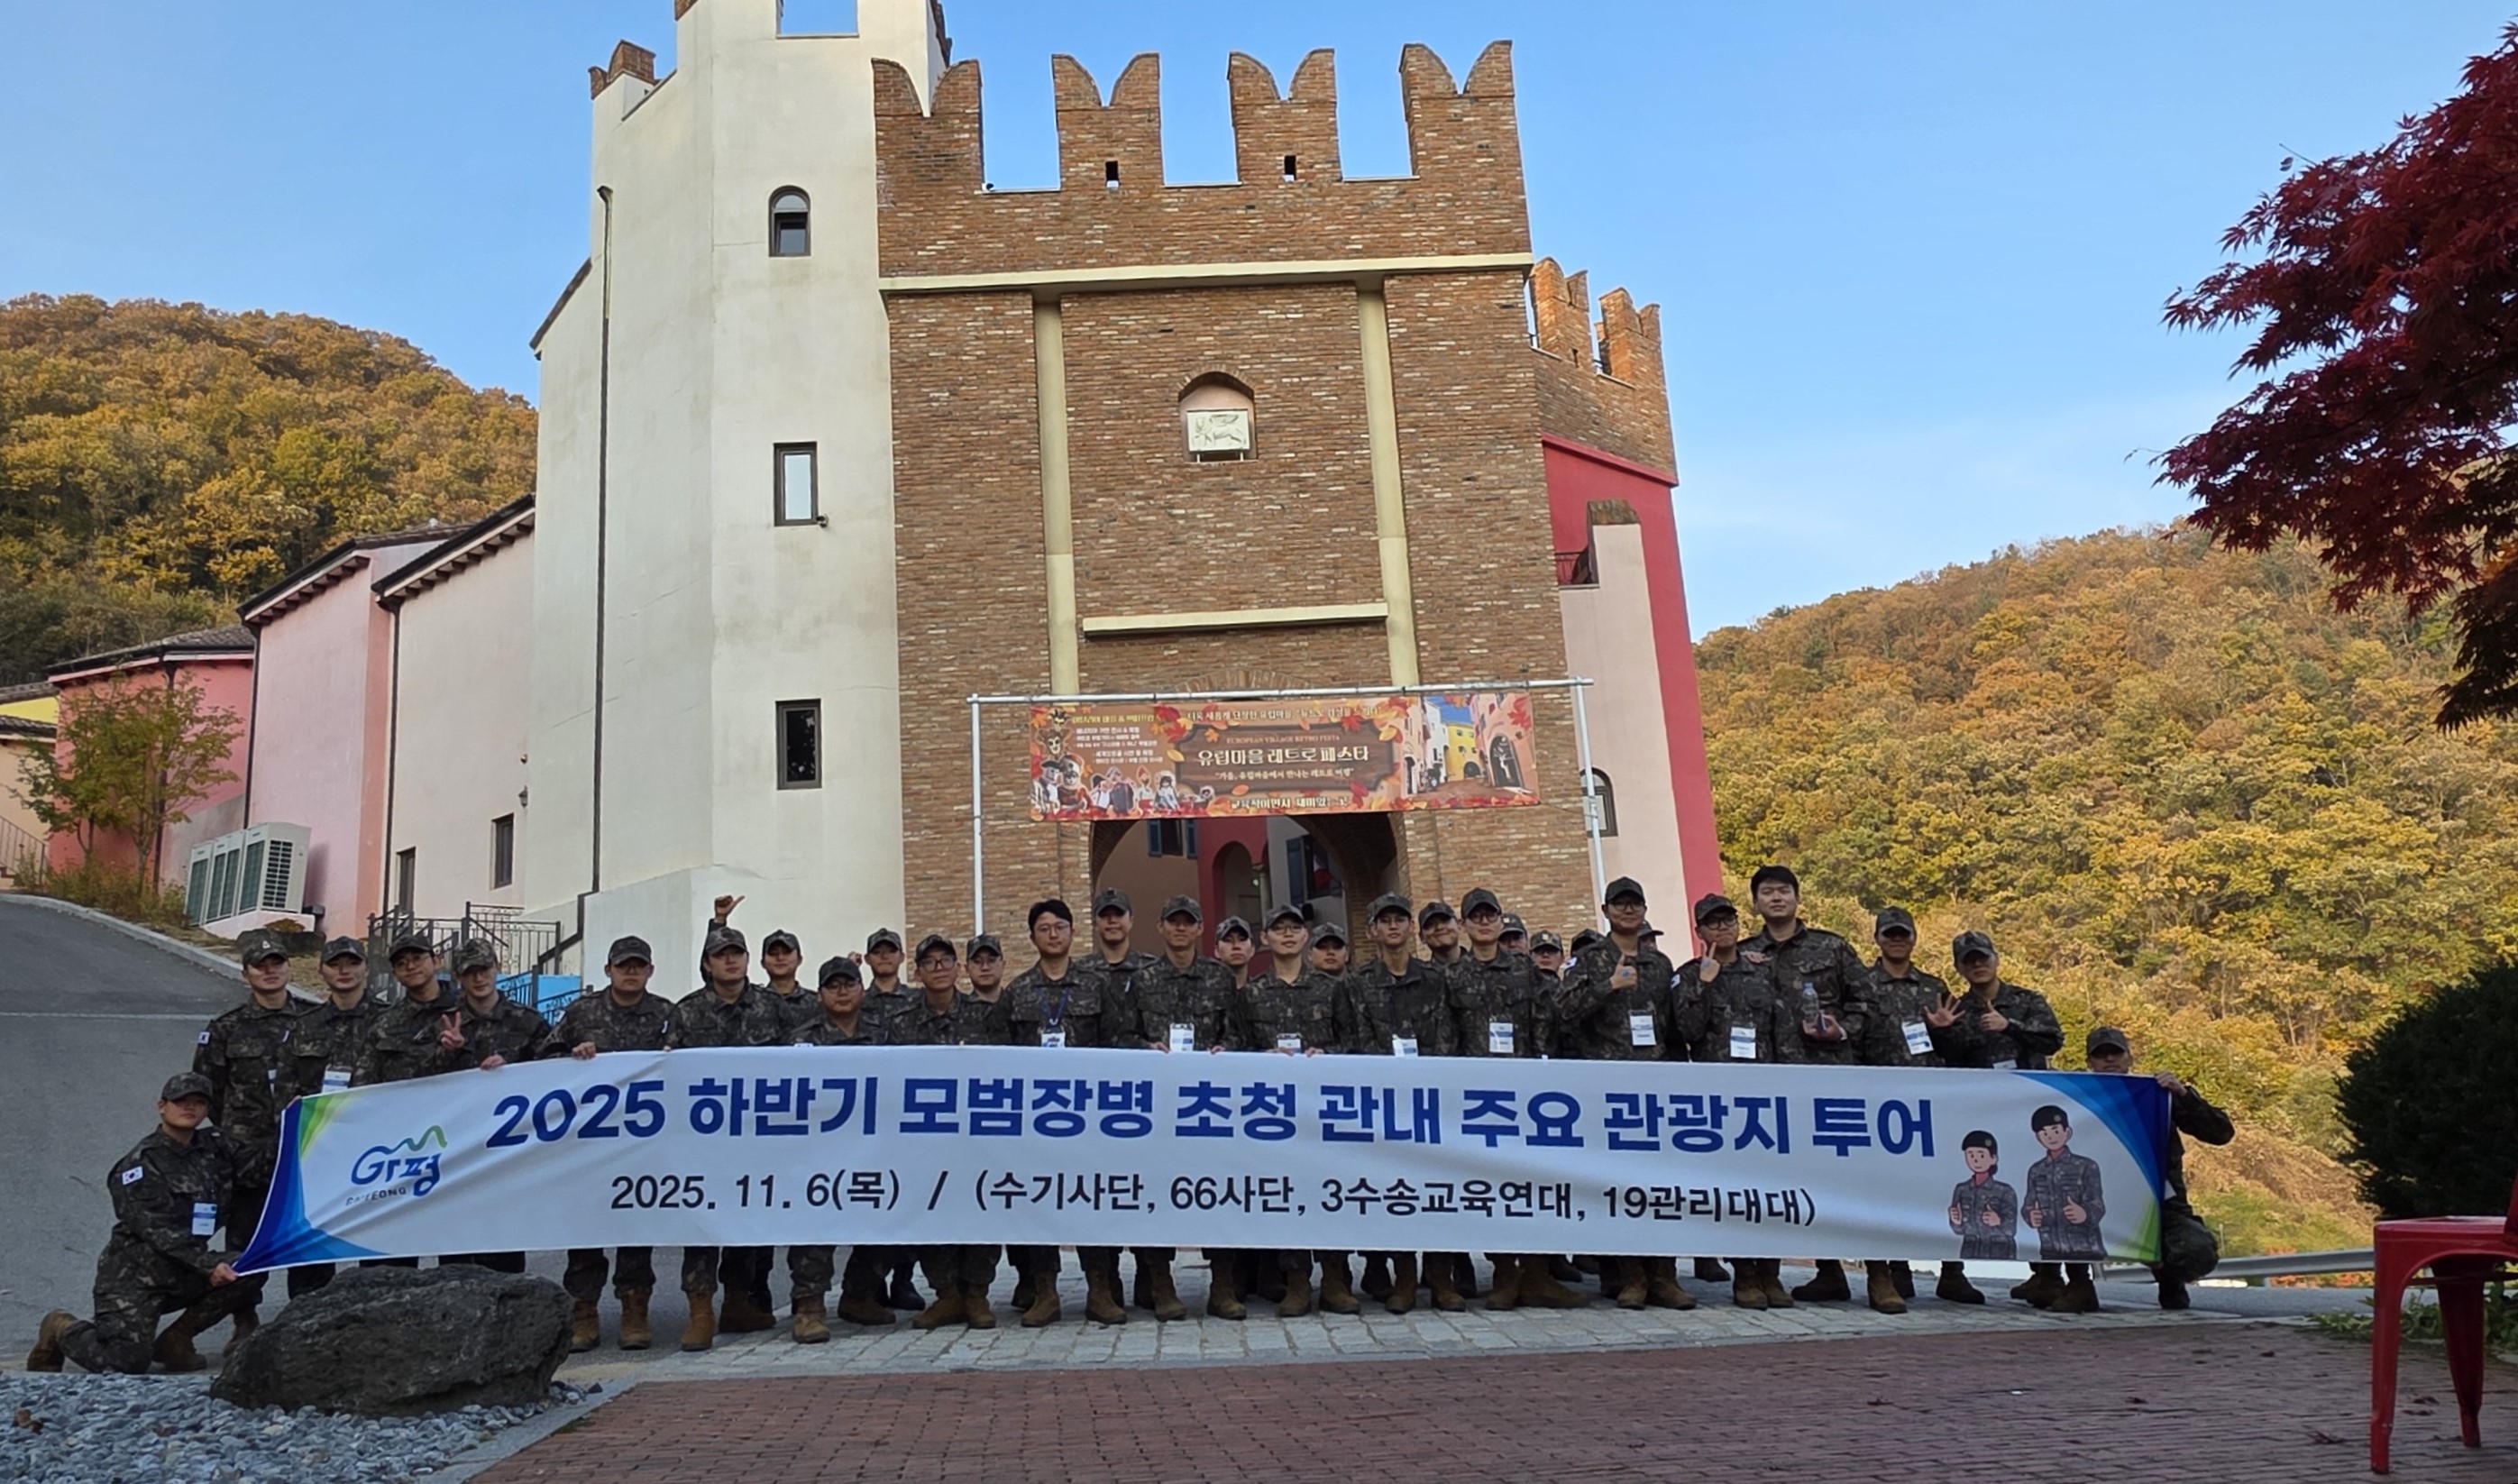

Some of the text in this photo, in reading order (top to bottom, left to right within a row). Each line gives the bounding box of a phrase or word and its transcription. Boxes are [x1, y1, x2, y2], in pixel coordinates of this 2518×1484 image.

[1198, 746, 1369, 766] 유럽마을 레트로 페스타
[486, 1077, 1935, 1158] 2025 하반기 모범장병 초청 관내 주요 관광지 투어
[611, 1175, 716, 1210] 2025.
[737, 1174, 791, 1209] 11.
[806, 1169, 901, 1210] 6(목)
[975, 1169, 1155, 1214] (수기사단,
[1170, 1175, 1305, 1215] 66사단,
[1321, 1177, 1586, 1221] 3수송교육연대,
[1603, 1186, 1816, 1227] 19관리대대)
